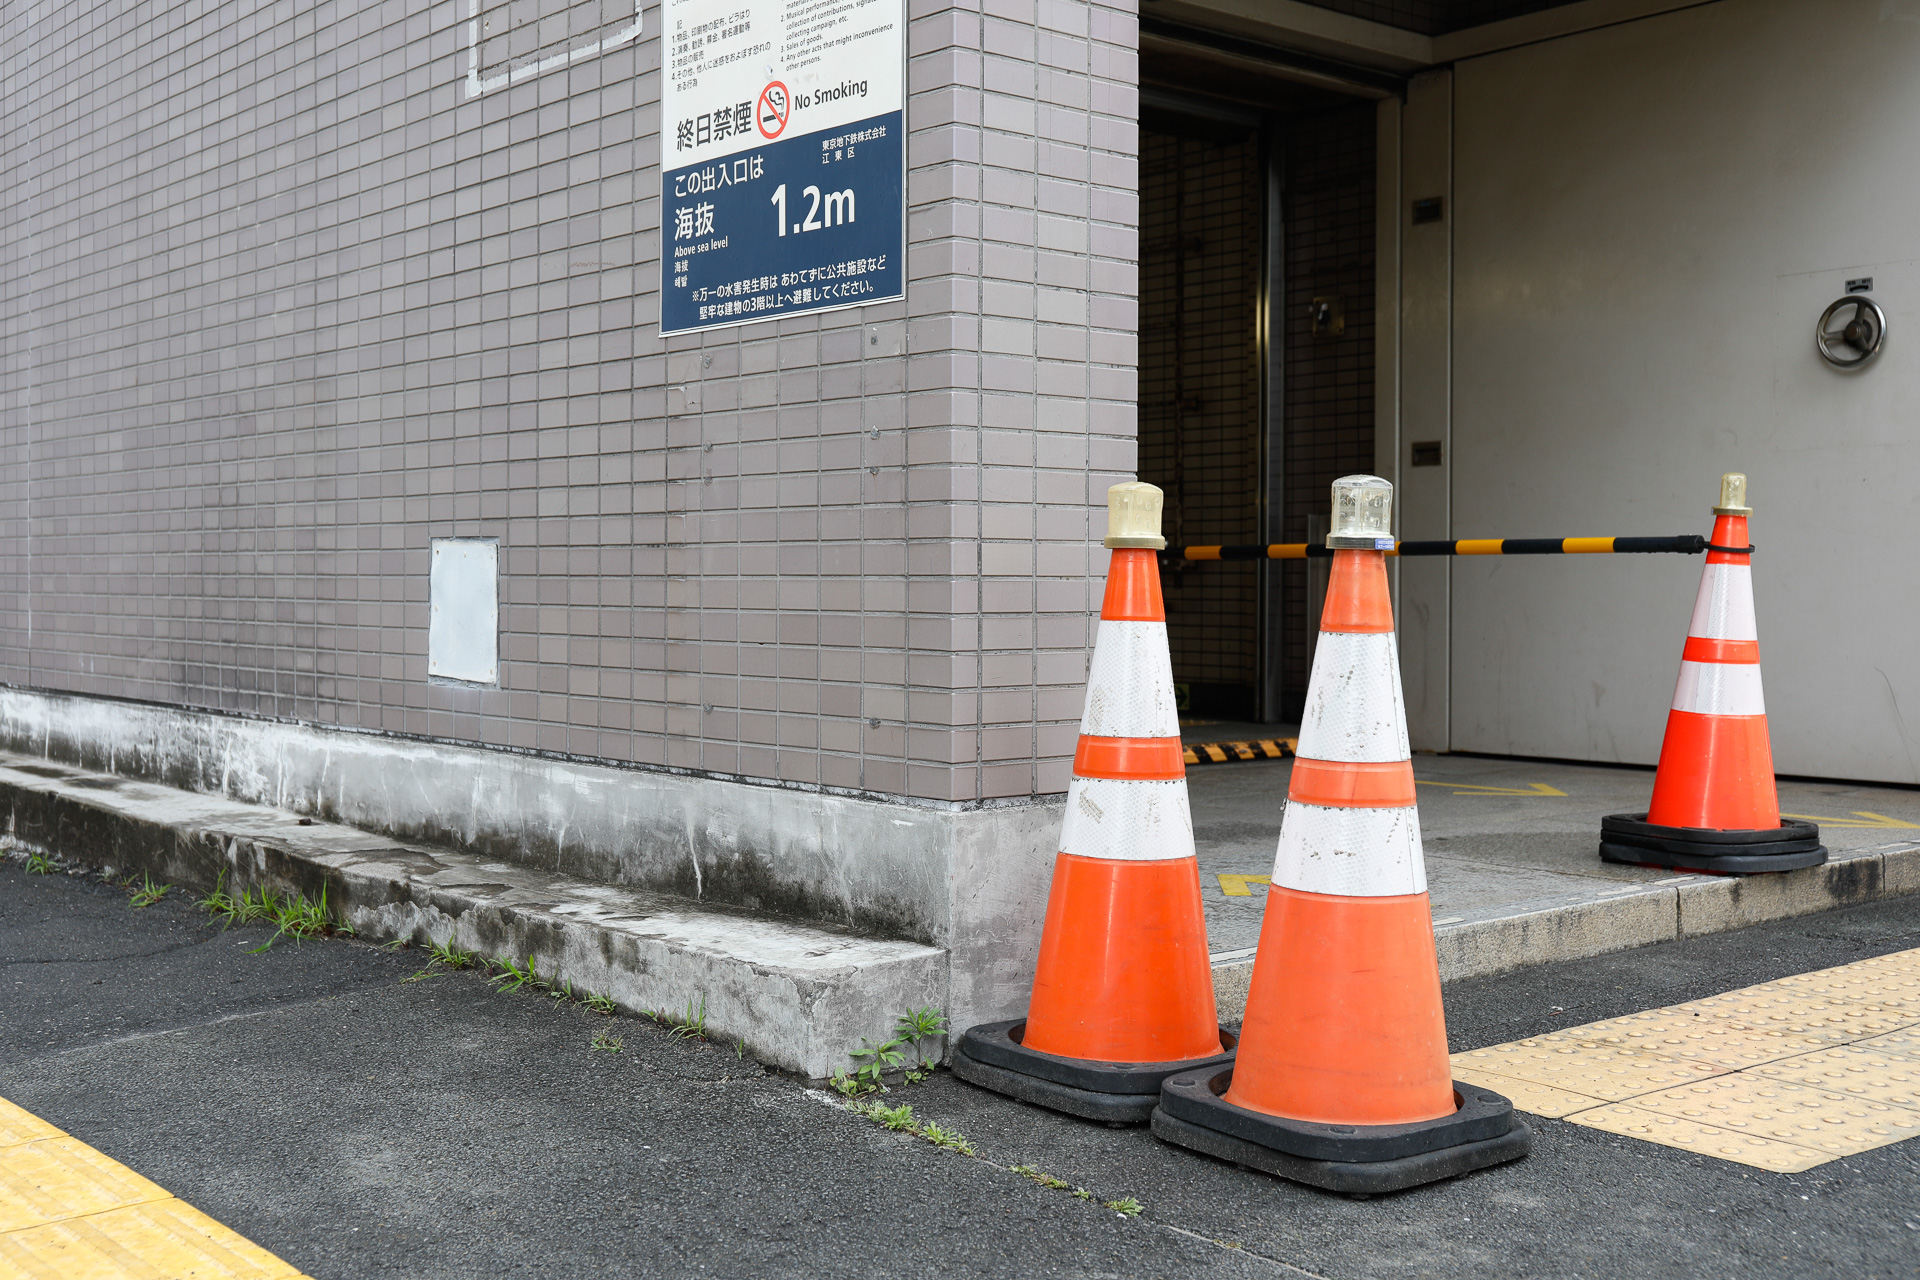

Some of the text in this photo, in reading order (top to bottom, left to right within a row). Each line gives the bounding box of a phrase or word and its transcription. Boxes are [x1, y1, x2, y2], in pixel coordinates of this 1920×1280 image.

[786, 7, 804, 20] Musical
[786, 17, 809, 30] collection
[810, 13, 816, 22] of
[786, 28, 809, 40] collecting
[838, 15, 849, 23] etc.
[786, 52, 796, 61] Any
[796, 48, 810, 57] other
[811, 45, 822, 53] acts
[822, 40, 834, 50] that
[835, 35, 852, 46] might
[853, 23, 893, 40] inconvenience
[786, 42, 798, 51] Sales
[799, 37, 806, 46] of
[786, 62, 799, 71] other
[794, 80, 868, 111] No Smoking
[676, 100, 752, 152] 終日禁煙
[822, 125, 887, 152] 東京地下鉄株式会社
[674, 154, 764, 198] この出入口は
[674, 201, 715, 241] 海抜
[770, 183, 856, 238] 1.2m
[674, 235, 728, 258] Above sea level
[699, 279, 874, 320] 堅牢な建物の3階以上へ避難してください。
